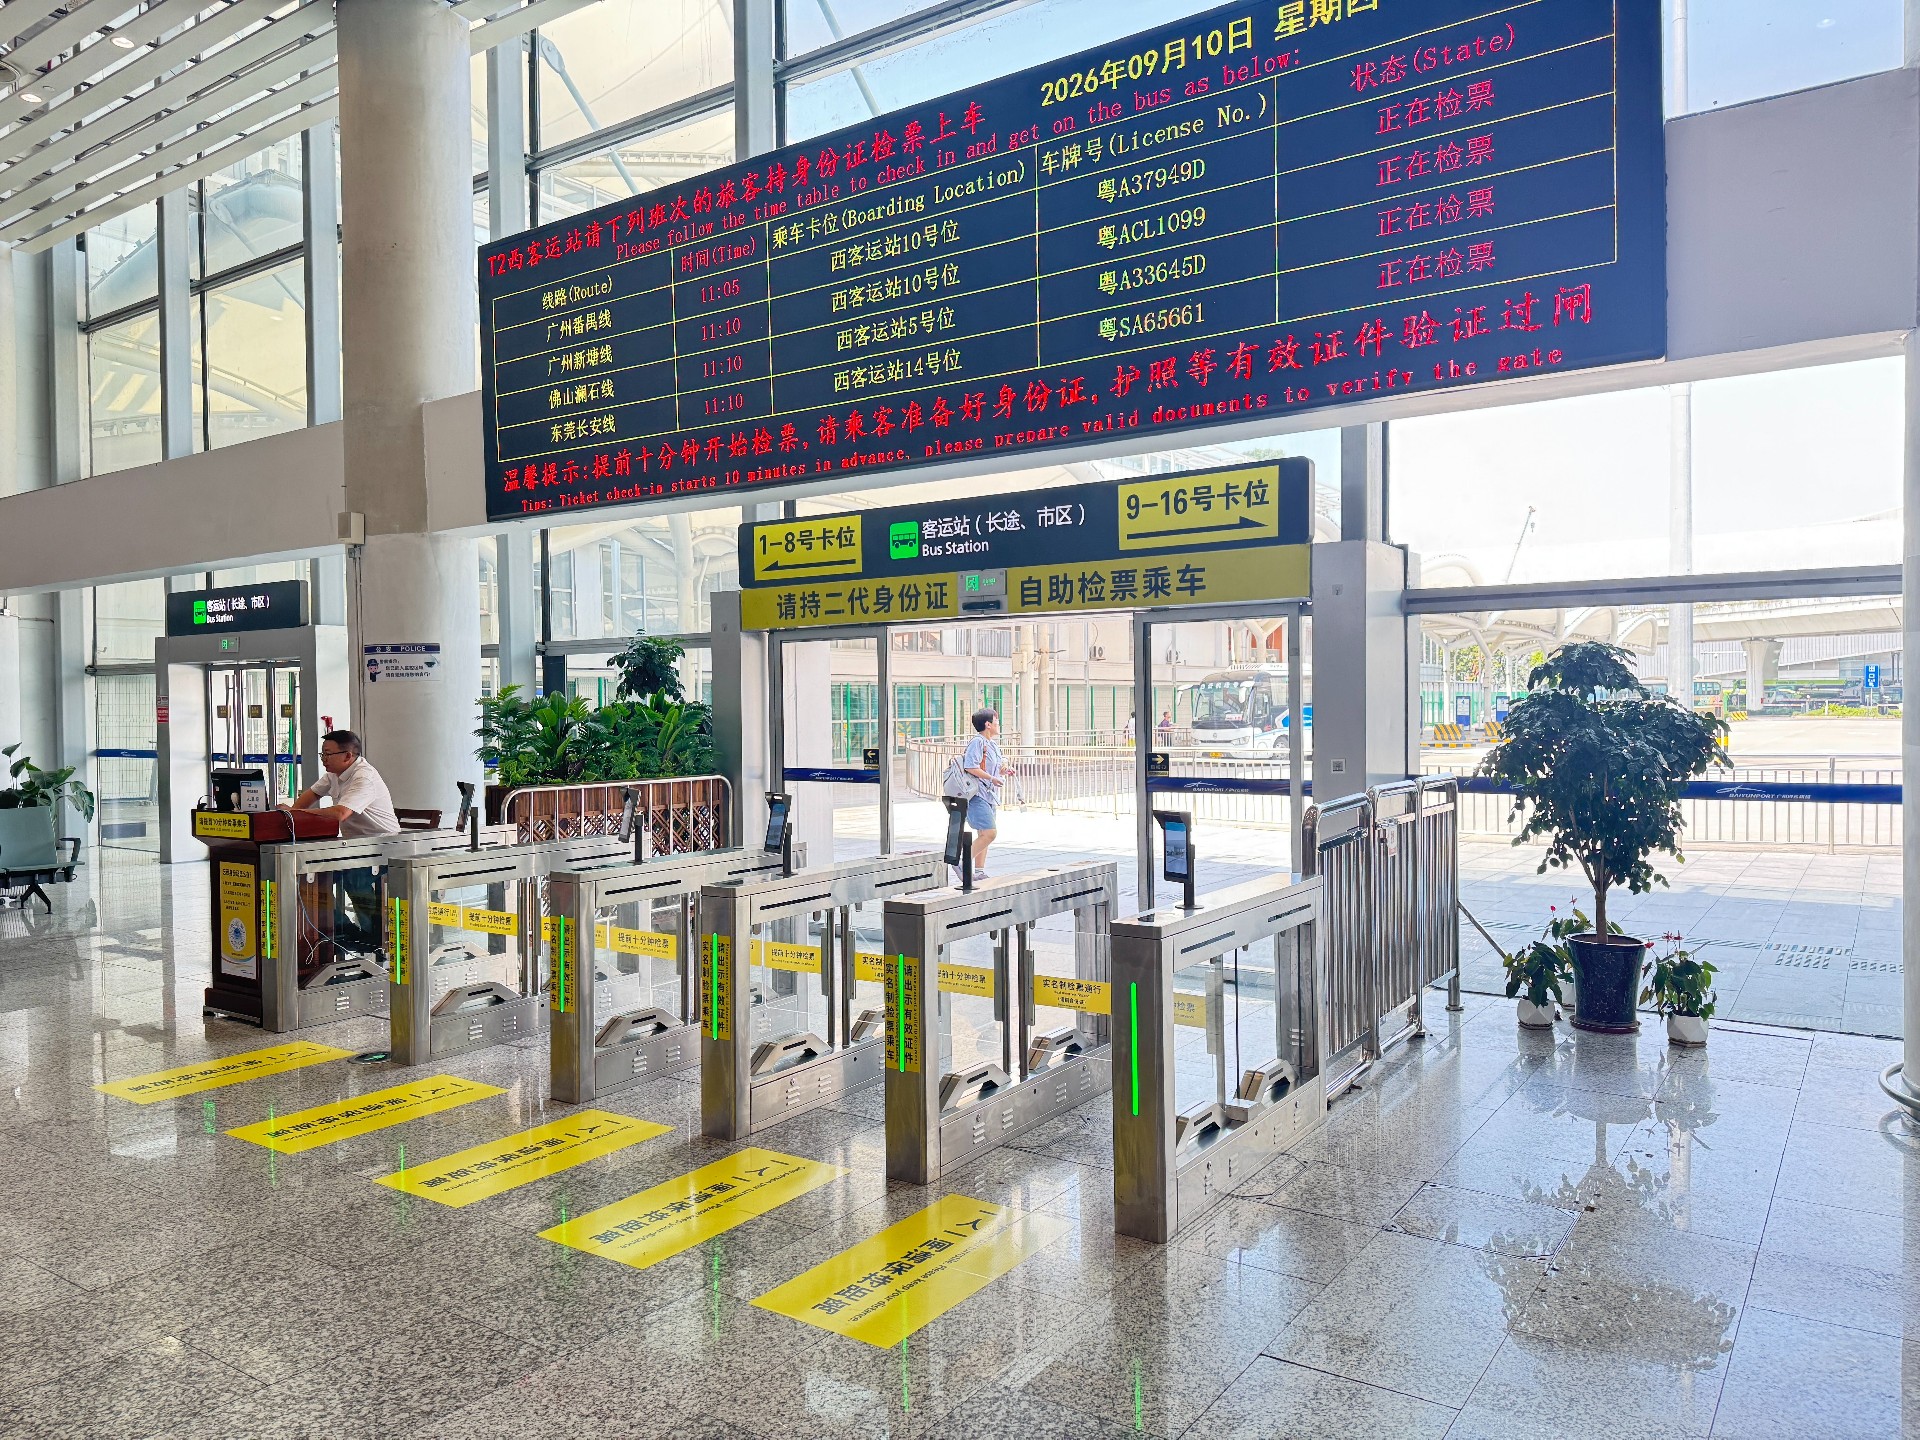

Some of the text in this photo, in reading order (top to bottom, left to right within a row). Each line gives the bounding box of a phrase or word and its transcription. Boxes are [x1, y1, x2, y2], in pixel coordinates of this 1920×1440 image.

[1040, 17, 1252, 106] 2026年09月10日
[1350, 22, 1516, 92] 状态(State)
[1375, 78, 1494, 135] 正在检票
[617, 48, 1299, 261] Please follow the time table to check in and get on the bus as below:
[1040, 117, 1204, 175] 车牌号(License
[1376, 132, 1494, 187] 正在检票
[487, 101, 985, 277] T2西客运站请下列班次的旅客持身份证检票上车
[1096, 157, 1205, 203] 粤A37949D
[772, 160, 1025, 250] 乘车卡位(Boarding Location)
[1376, 186, 1495, 239] 正在检票
[830, 220, 960, 271] 西客运站10号位
[1096, 207, 1206, 251] 粤ACL1099
[681, 237, 756, 273] 时间(Time)
[1097, 253, 1206, 297] 粤A33645D
[1377, 241, 1495, 292] 正在检票
[542, 275, 613, 310] 线路(Route)
[700, 280, 740, 304] 11:05
[831, 263, 960, 313] 西客运站10号位
[546, 309, 612, 342] 广州番禺线
[701, 318, 741, 342] 11:10
[836, 307, 956, 353] 西客运站5号位
[1097, 301, 1205, 343] 粤SA65661
[547, 343, 612, 377] 广州新塘线
[702, 355, 742, 380] 11:10
[834, 348, 962, 393] 西客运站14号位
[548, 379, 615, 410] 佛山澜石线
[703, 393, 744, 416] 11:10
[522, 498, 552, 512] Tips:
[559, 490, 599, 507] Ticket
[607, 481, 662, 501] check-in
[671, 476, 716, 493] starts
[725, 470, 739, 485] 10
[748, 462, 805, 482] minutes
[815, 458, 831, 473] in
[925, 436, 983, 456] please
[995, 426, 1069, 449] prepare
[1083, 410, 1139, 434] valid
[1153, 391, 1268, 422] documents
[1284, 385, 1309, 403] to
[1326, 368, 1413, 396] verify
[1433, 359, 1478, 380] the
[1498, 347, 1563, 373] gate
[550, 414, 616, 445] 东莞长安线
[922, 503, 1087, 540] 客运站（长途、市区）
[1126, 480, 1270, 520] 9-16号卡位
[758, 525, 856, 555] 1-8号卡位
[922, 537, 989, 557] Bus Station
[777, 582, 949, 621] 请持二代身份证
[1019, 564, 1206, 607] 自助检票乘车
[207, 615, 216, 624] Bus
[885, 962, 894, 1060] 实名制验票乘车
[904, 964, 913, 1064] 请出示有效证件
[592, 1160, 785, 1243] 一人一闸请保持距离
[813, 1210, 1000, 1314] 一人一闸请保持距离
[900, 1278, 924, 1290] keep
[845, 1300, 886, 1322] distance.
[881, 1289, 905, 1301] your
